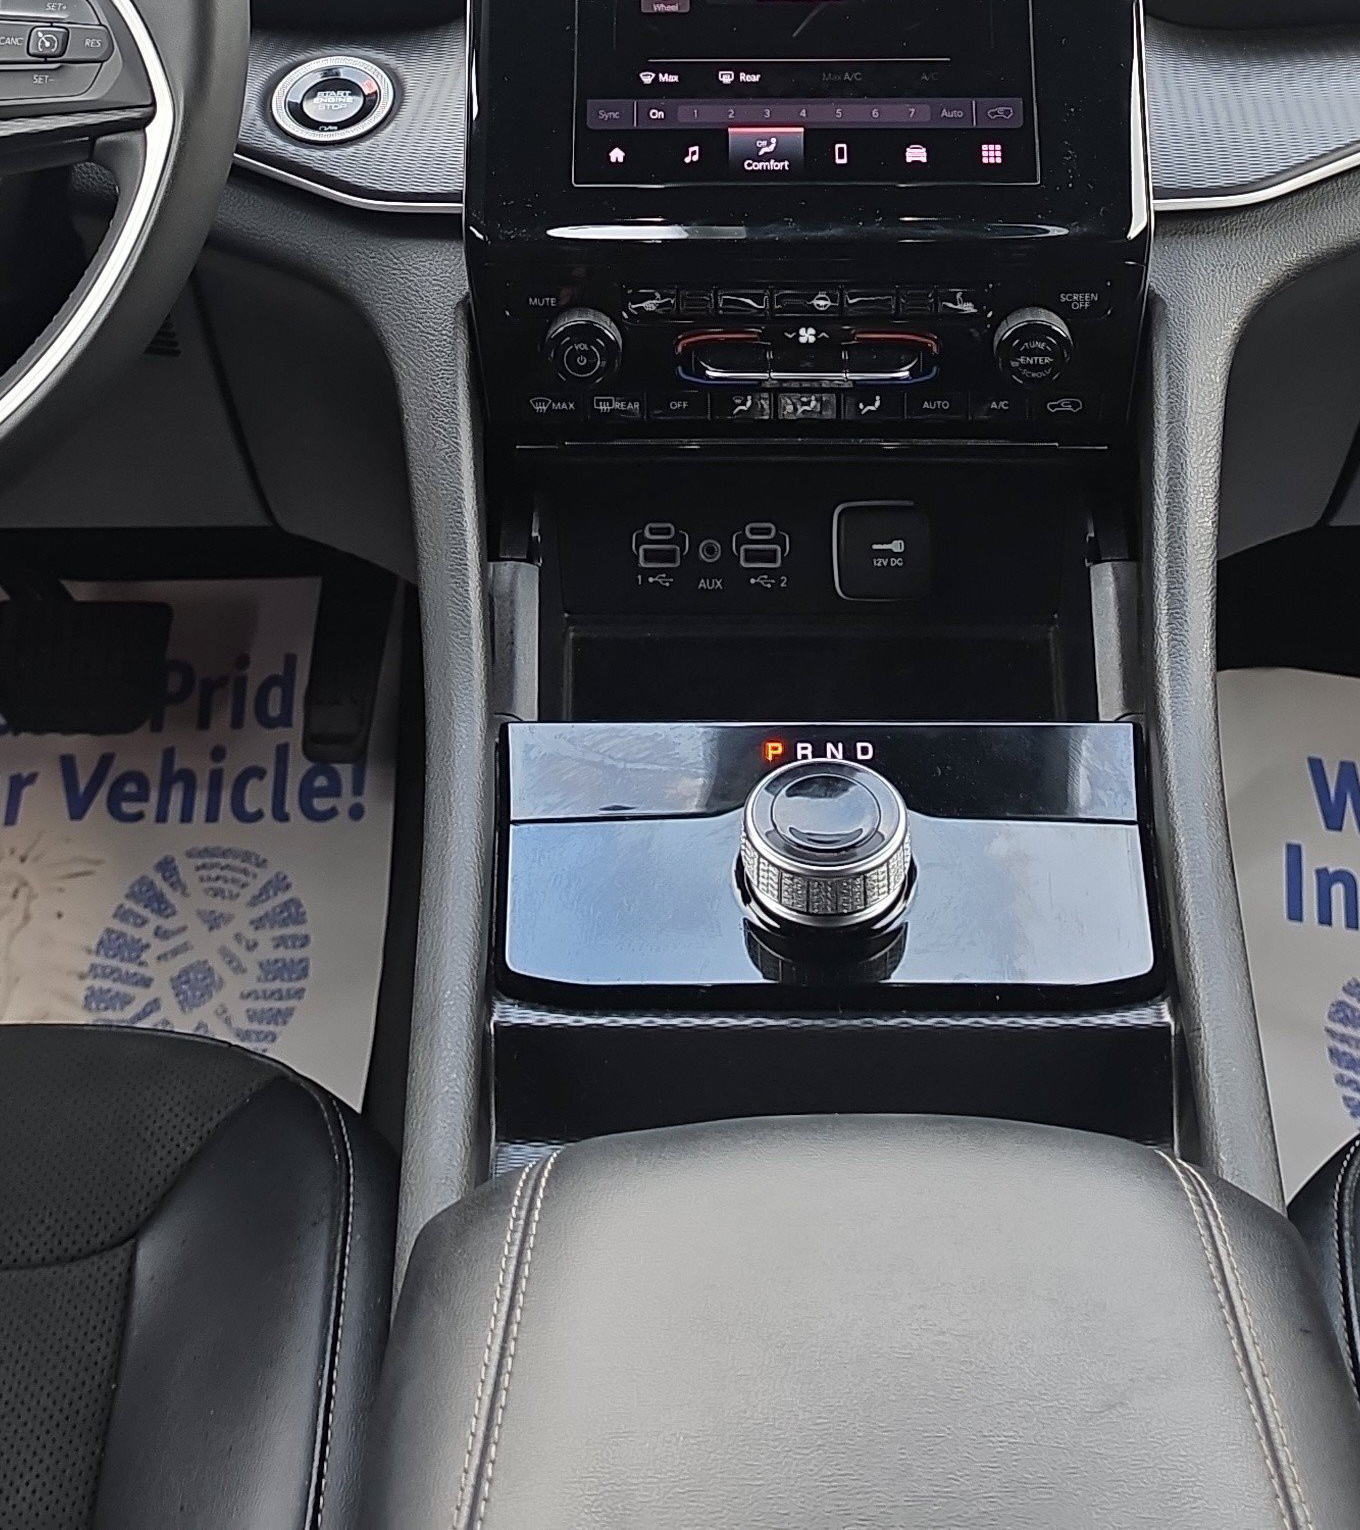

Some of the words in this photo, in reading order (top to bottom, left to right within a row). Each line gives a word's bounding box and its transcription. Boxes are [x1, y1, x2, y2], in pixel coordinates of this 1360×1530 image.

[653, 3, 679, 12] Wheel
[84, 39, 102, 48] RES
[658, 72, 679, 82] Max
[739, 72, 762, 82] Rear
[598, 109, 620, 121] Sync
[649, 108, 665, 119] On
[941, 108, 964, 119] Auto
[744, 158, 789, 170] Comfort
[528, 297, 556, 306] MUTE
[1060, 293, 1098, 302] SCREEN
[1071, 302, 1091, 310] OFF
[574, 343, 589, 351] VOL
[1024, 341, 1047, 350] TUNE
[1020, 356, 1050, 365] ENTER
[552, 401, 575, 410] MAX
[614, 401, 640, 410] REAR
[669, 400, 688, 410] OFF
[922, 400, 950, 410] AUTO
[990, 400, 1010, 410] A/C
[872, 558, 889, 567] 12V
[889, 557, 904, 566] DC
[697, 578, 723, 590] AUX
[780, 576, 787, 588] 2
[150, 651, 298, 731] Prid
[766, 741, 783, 761] P
[796, 742, 813, 759] R
[826, 742, 843, 760] N
[856, 742, 874, 759] D
[59, 743, 368, 825] Vehicle!
[1284, 842, 1360, 933] In
